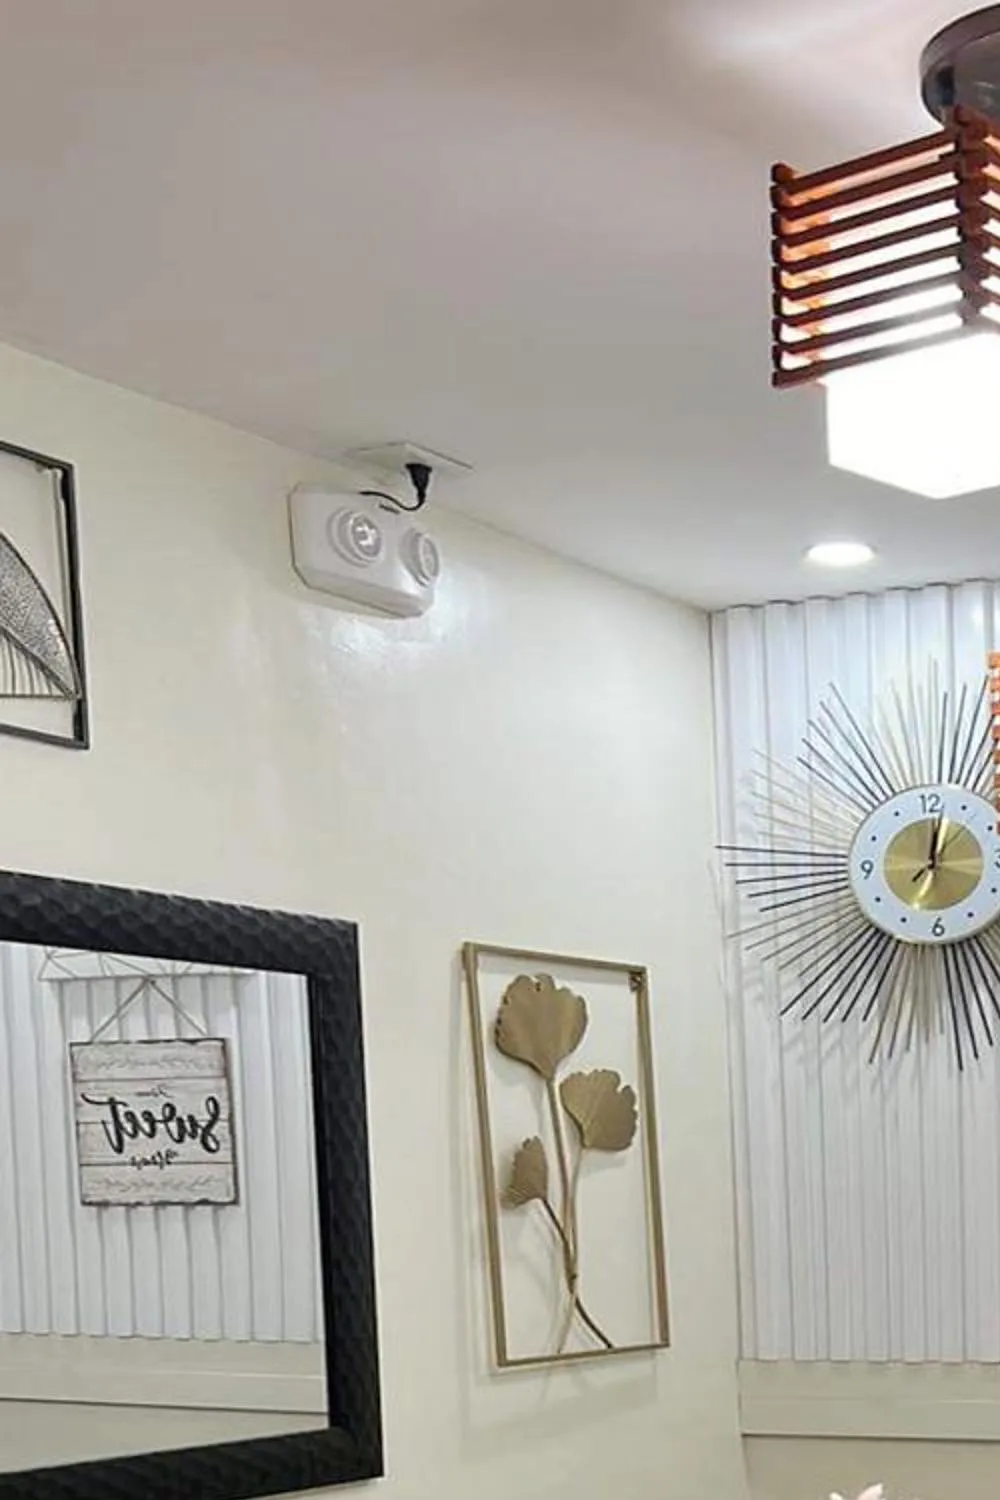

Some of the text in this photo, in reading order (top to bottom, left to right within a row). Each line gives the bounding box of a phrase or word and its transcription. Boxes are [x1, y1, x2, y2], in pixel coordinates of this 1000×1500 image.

[918, 793, 942, 814] 12
[860, 859, 874, 880] 9
[930, 916, 945, 937] 6
